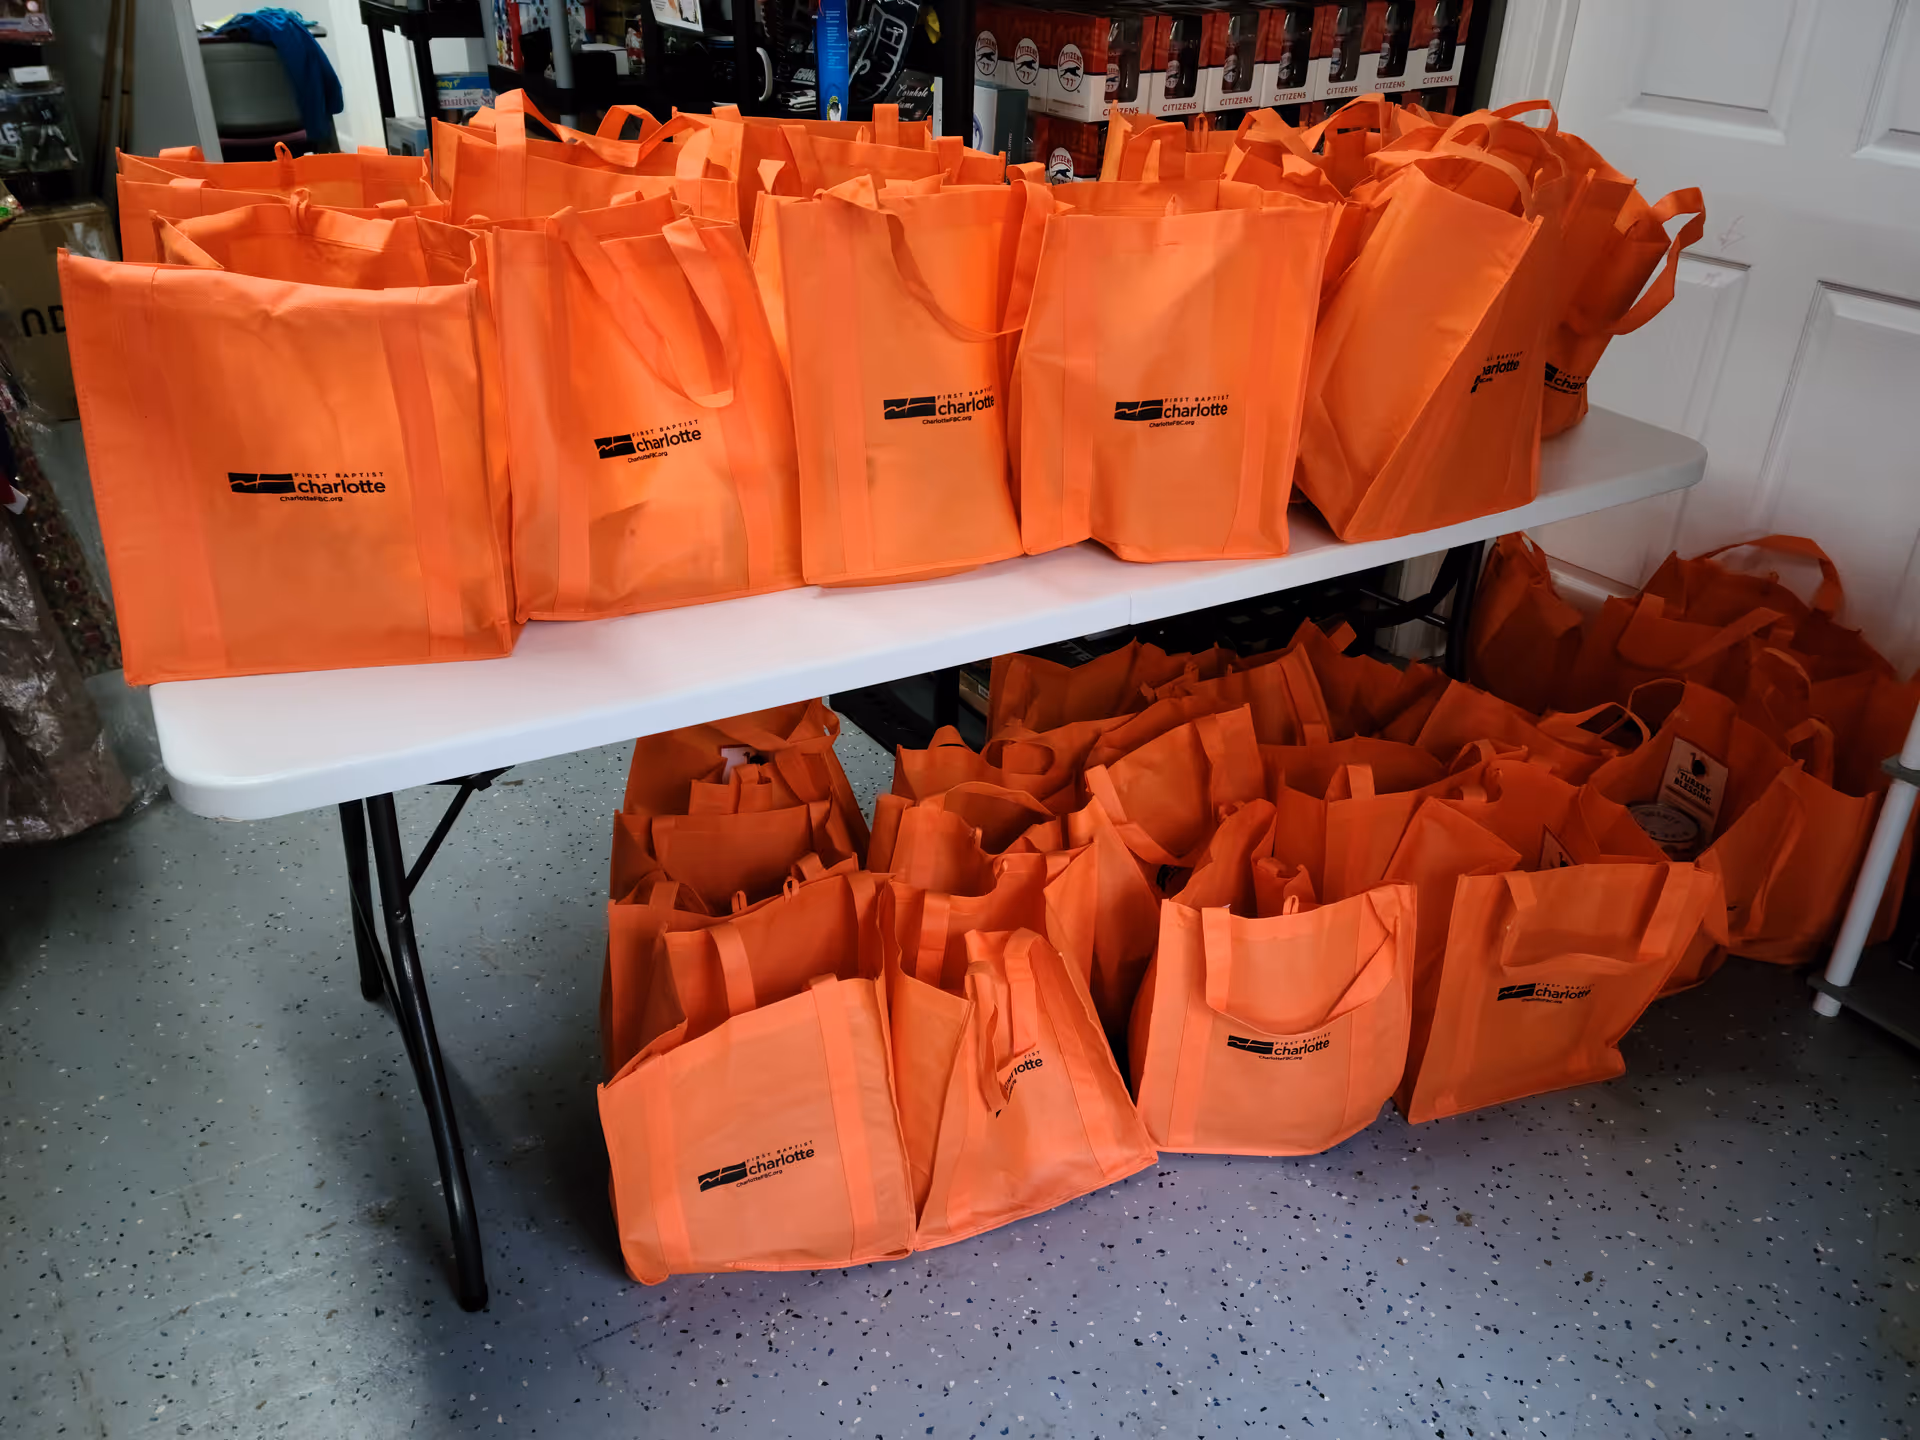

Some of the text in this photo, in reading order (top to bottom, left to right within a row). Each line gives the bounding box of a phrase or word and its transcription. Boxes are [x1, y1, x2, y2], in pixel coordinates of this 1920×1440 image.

[1374, 80, 1406, 90] CITIZENS
[1422, 75, 1453, 85] CITIZENS
[896, 83, 929, 98] Cornhole
[1274, 91, 1307, 102] CITIZENS
[1326, 85, 1358, 96] CITIZENS
[440, 95, 478, 106] ensitive
[1162, 102, 1197, 112] CITIZENS
[1219, 95, 1253, 106] CITIZENS
[937, 392, 963, 400] FIRST
[1194, 394, 1230, 402] BAPTIST
[937, 395, 995, 416] charlotte
[1163, 402, 1228, 419] charlotte
[631, 419, 699, 438] FIRST BAPTIST
[636, 429, 702, 452] charlotte
[335, 471, 384, 479] BAPTIST
[297, 479, 386, 494] charlotte
[1680, 772, 1712, 795] TURKEY
[1673, 777, 1713, 806] BLESSING
[1273, 1039, 1331, 1056] charlotte
[746, 1140, 813, 1163] FIRST BAPTIST
[748, 1148, 815, 1175] charlotte
[735, 1168, 783, 1188] CharlotteFBC.org
